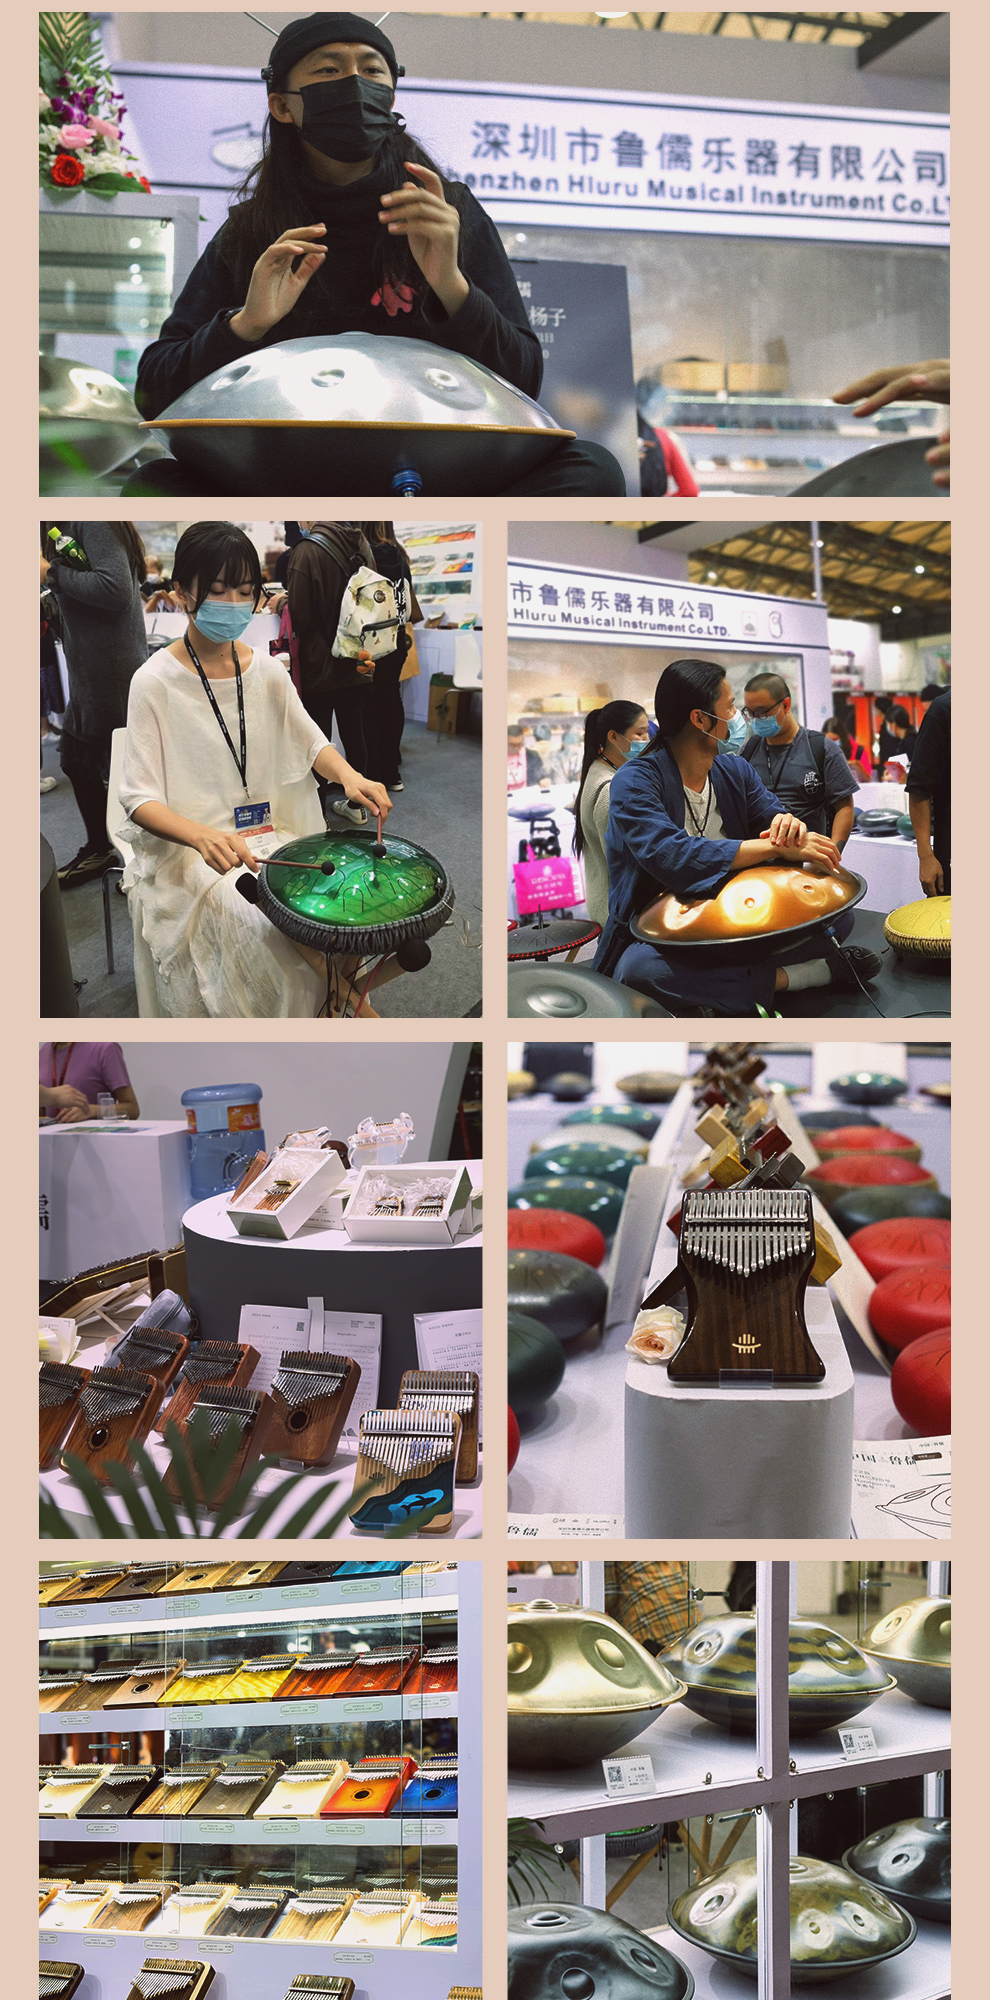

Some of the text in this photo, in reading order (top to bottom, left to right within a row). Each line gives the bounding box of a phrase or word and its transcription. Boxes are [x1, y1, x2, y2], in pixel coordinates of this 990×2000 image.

[471, 120, 946, 188] 深圳市鲁儒乐器有限公司
[447, 167, 559, 192] henzhen
[648, 179, 743, 204] Musical
[752, 185, 883, 212] Instrument
[509, 580, 714, 622] 市鲁儒乐器有限公司
[561, 612, 615, 627] Musical
[619, 617, 686, 633] Instrument
